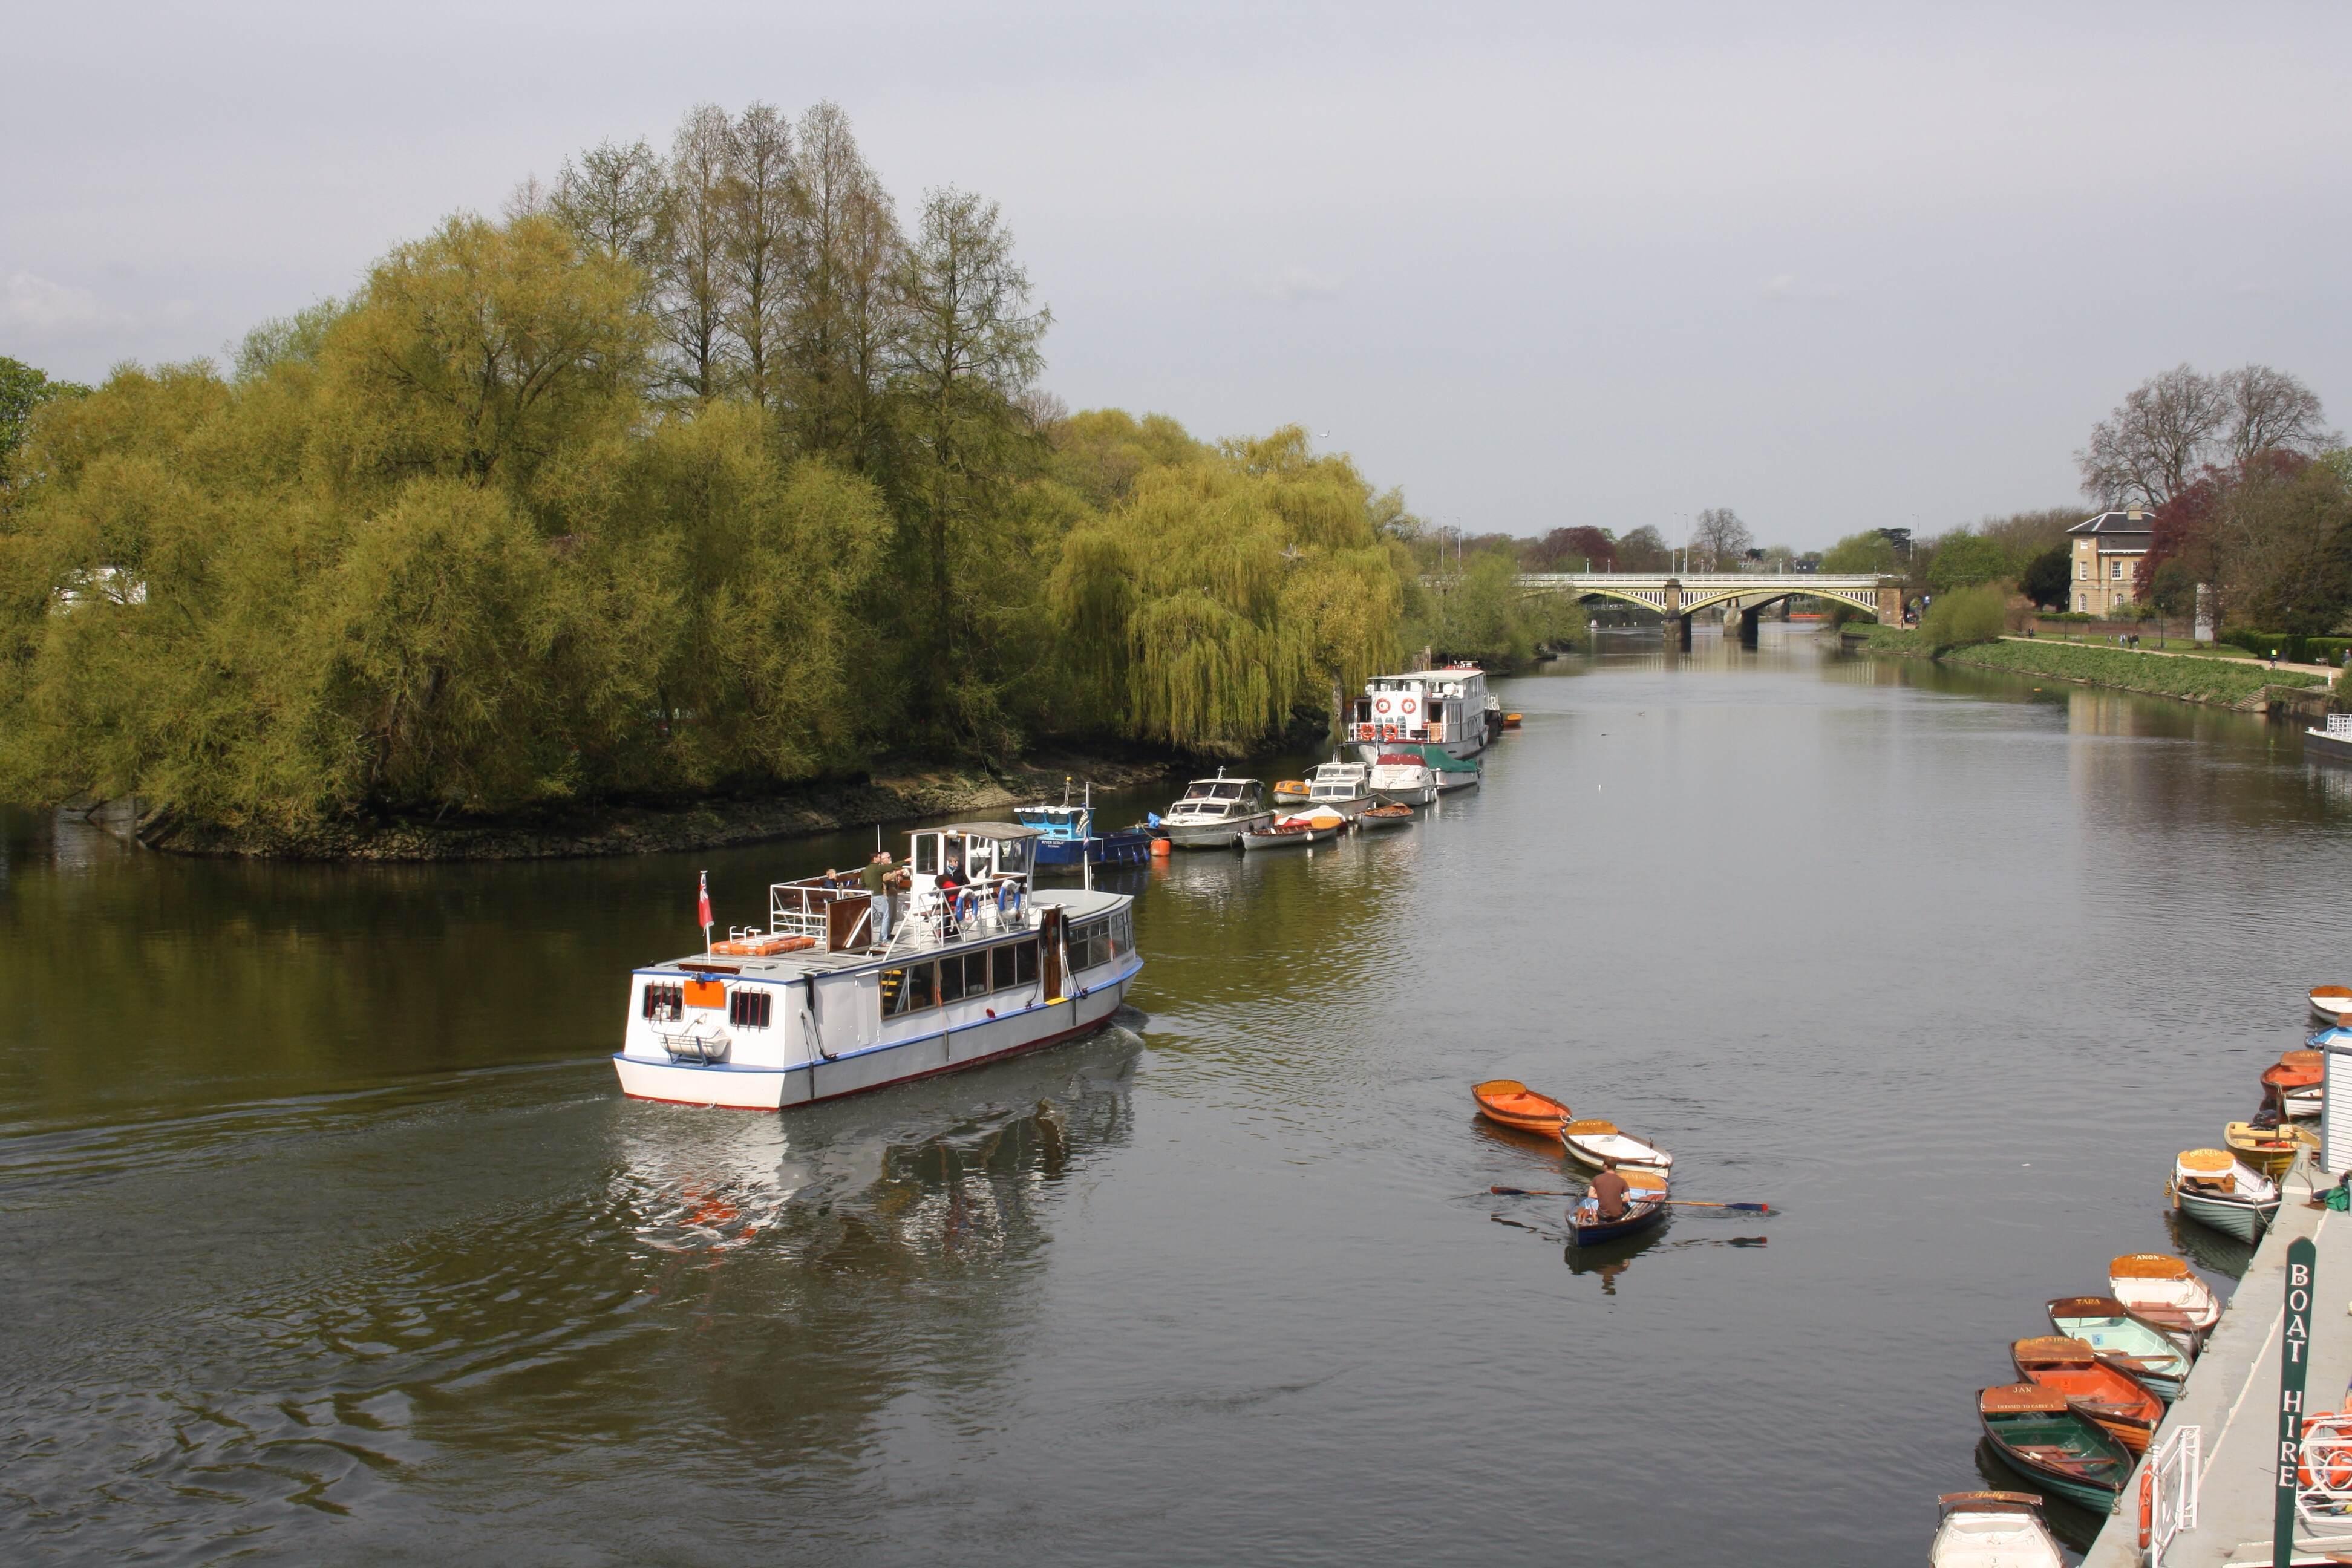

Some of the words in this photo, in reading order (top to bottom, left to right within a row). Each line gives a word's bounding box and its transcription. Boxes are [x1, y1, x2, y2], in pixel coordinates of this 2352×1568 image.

[2286, 1263, 2308, 1362] BOAT
[2279, 1390, 2302, 1487] HIRE
[1975, 1491, 2004, 1500] Shelly
